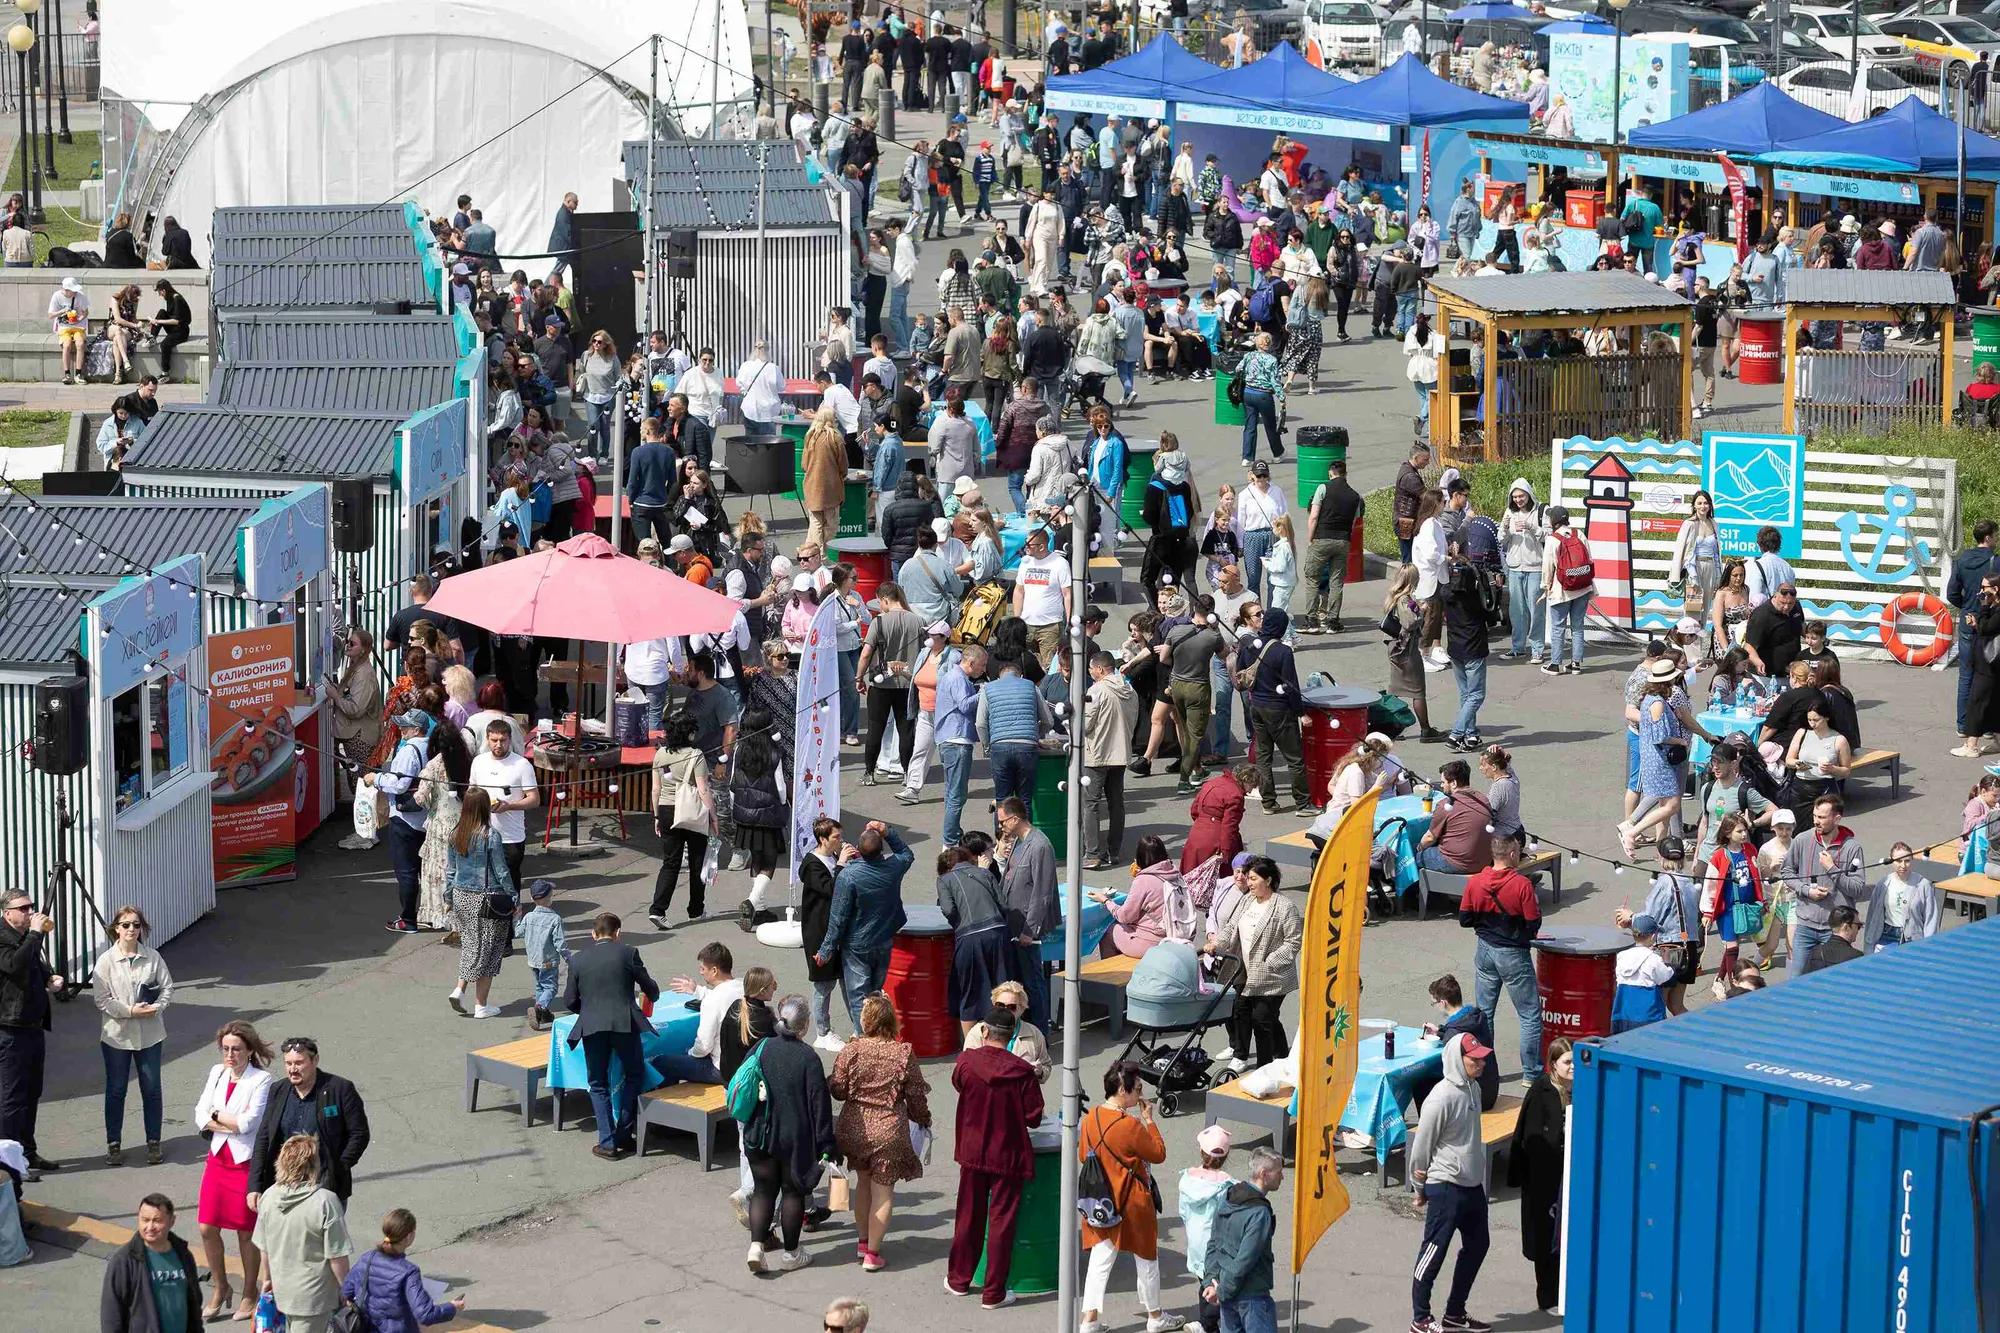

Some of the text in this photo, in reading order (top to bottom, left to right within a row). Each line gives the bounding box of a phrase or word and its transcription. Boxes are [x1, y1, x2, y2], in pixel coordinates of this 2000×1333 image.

[1745, 343, 1763, 352] VISIT
[1745, 350, 1779, 359] PRIMORYE
[1720, 528, 1741, 540] SIT
[244, 644, 272, 655] TOKYO
[217, 660, 286, 683] КАЛИФОРНИЯ
[216, 678, 287, 697] БЛИЖЕ, ЧЕМ ВЫ
[229, 693, 273, 709] ДУМАЕТЕ!
[1744, 1062, 1790, 1075] CICU
[1895, 1169, 1913, 1333] CICU 490
